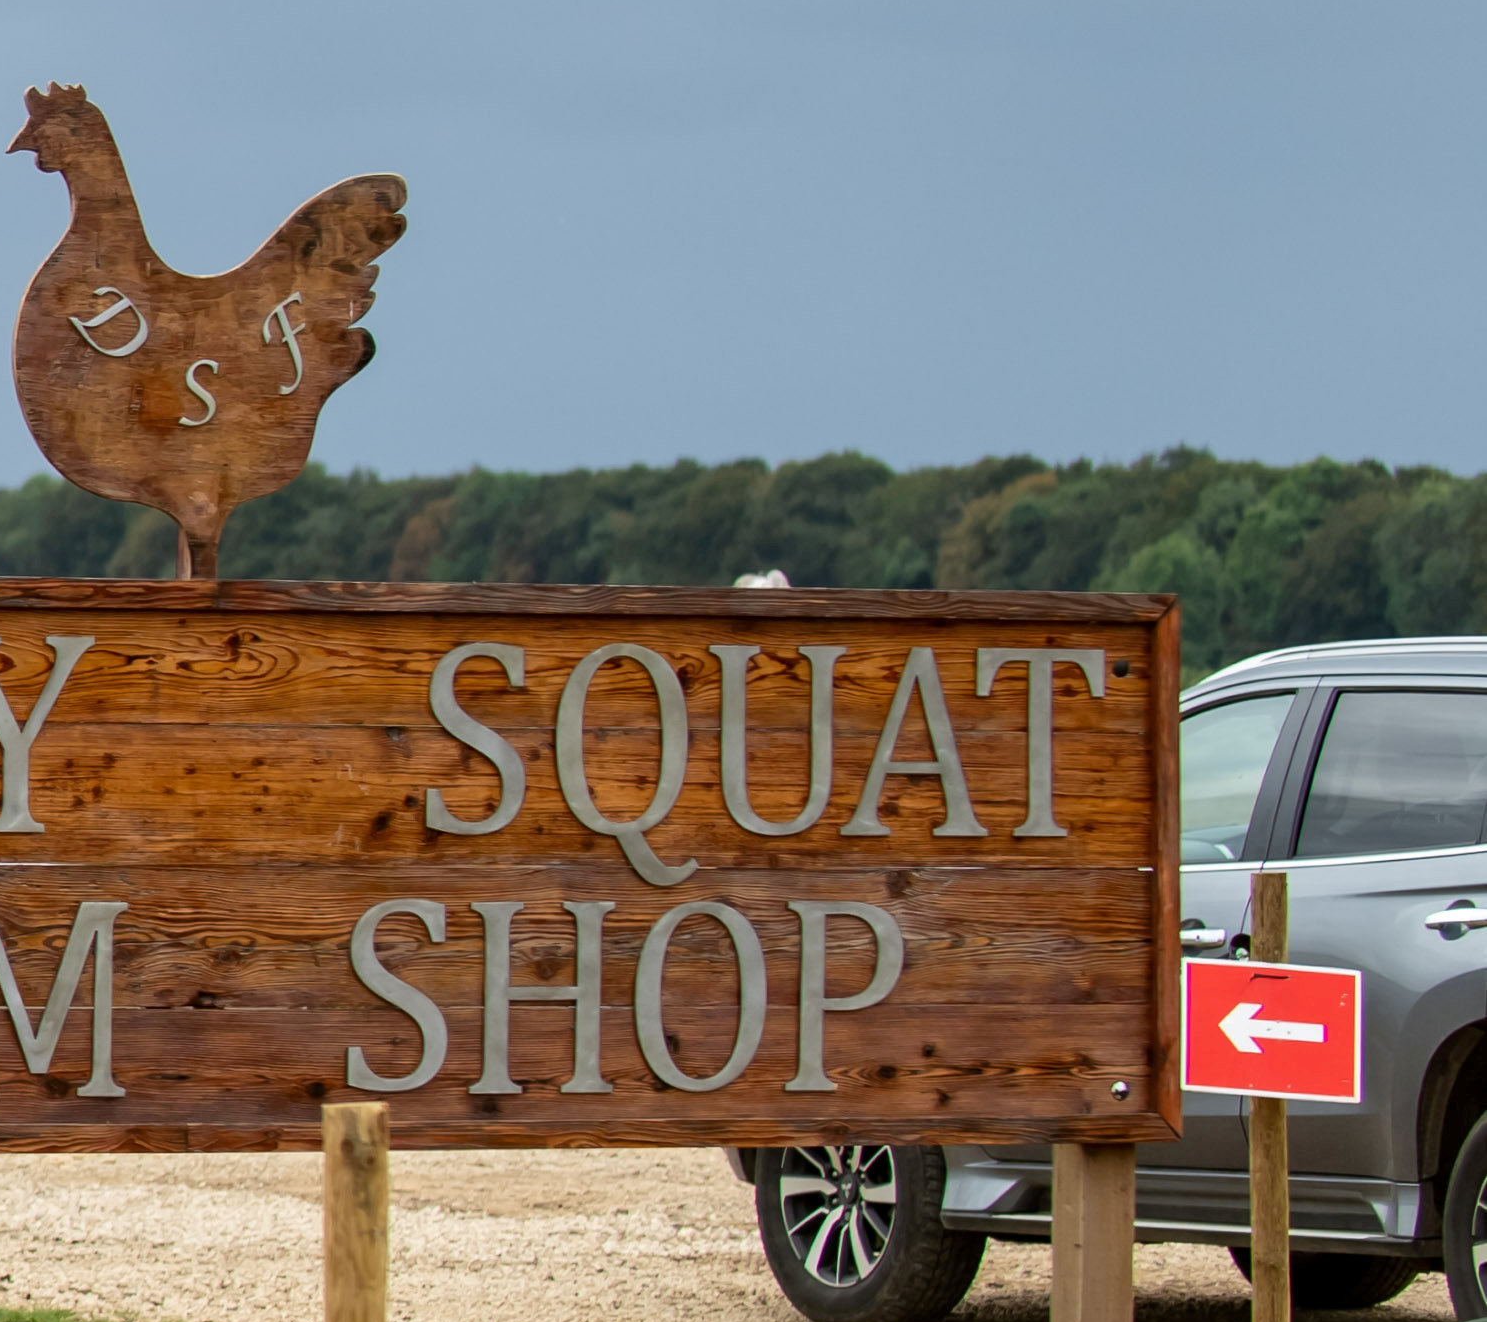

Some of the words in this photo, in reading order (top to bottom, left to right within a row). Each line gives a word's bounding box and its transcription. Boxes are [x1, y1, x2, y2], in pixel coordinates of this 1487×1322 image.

[178, 359, 220, 427] S
[424, 640, 1107, 888] SQUAT
[345, 898, 905, 1098] SHOP
